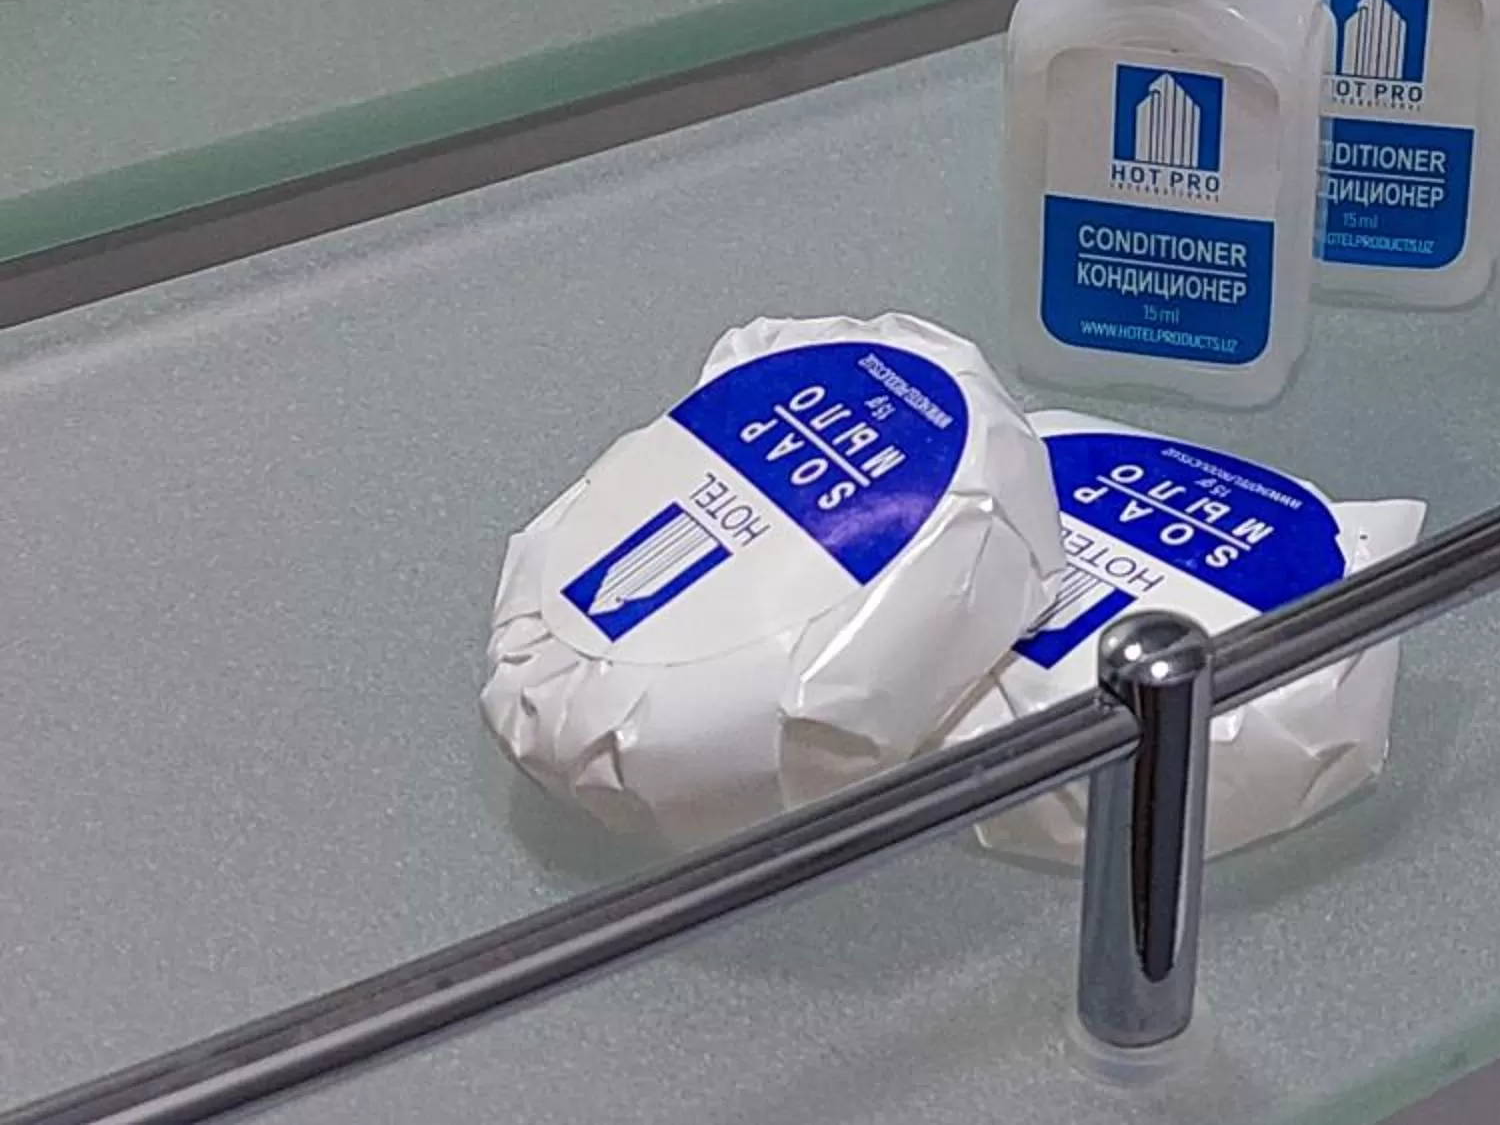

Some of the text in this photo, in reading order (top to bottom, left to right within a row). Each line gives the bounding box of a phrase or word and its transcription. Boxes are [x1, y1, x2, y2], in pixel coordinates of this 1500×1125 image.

[1332, 78, 1423, 103] OT PRO
[1110, 163, 1161, 185] HOT
[1169, 170, 1220, 193] PRO
[1323, 139, 1447, 174] DITIONER
[1326, 177, 1445, 209] ДИЦИОНЕР
[1343, 211, 1357, 228] 15
[1077, 223, 1248, 268] CONDITIONER
[1076, 260, 1248, 305] КОНДИЦИОНЕР
[1143, 303, 1181, 325] 15 ml
[787, 384, 907, 480] МЫЛО
[738, 416, 857, 511] SOAP
[688, 471, 771, 548] HOTEL
[1109, 462, 1276, 546] МЫЛО
[1073, 485, 1241, 569] SOAP
